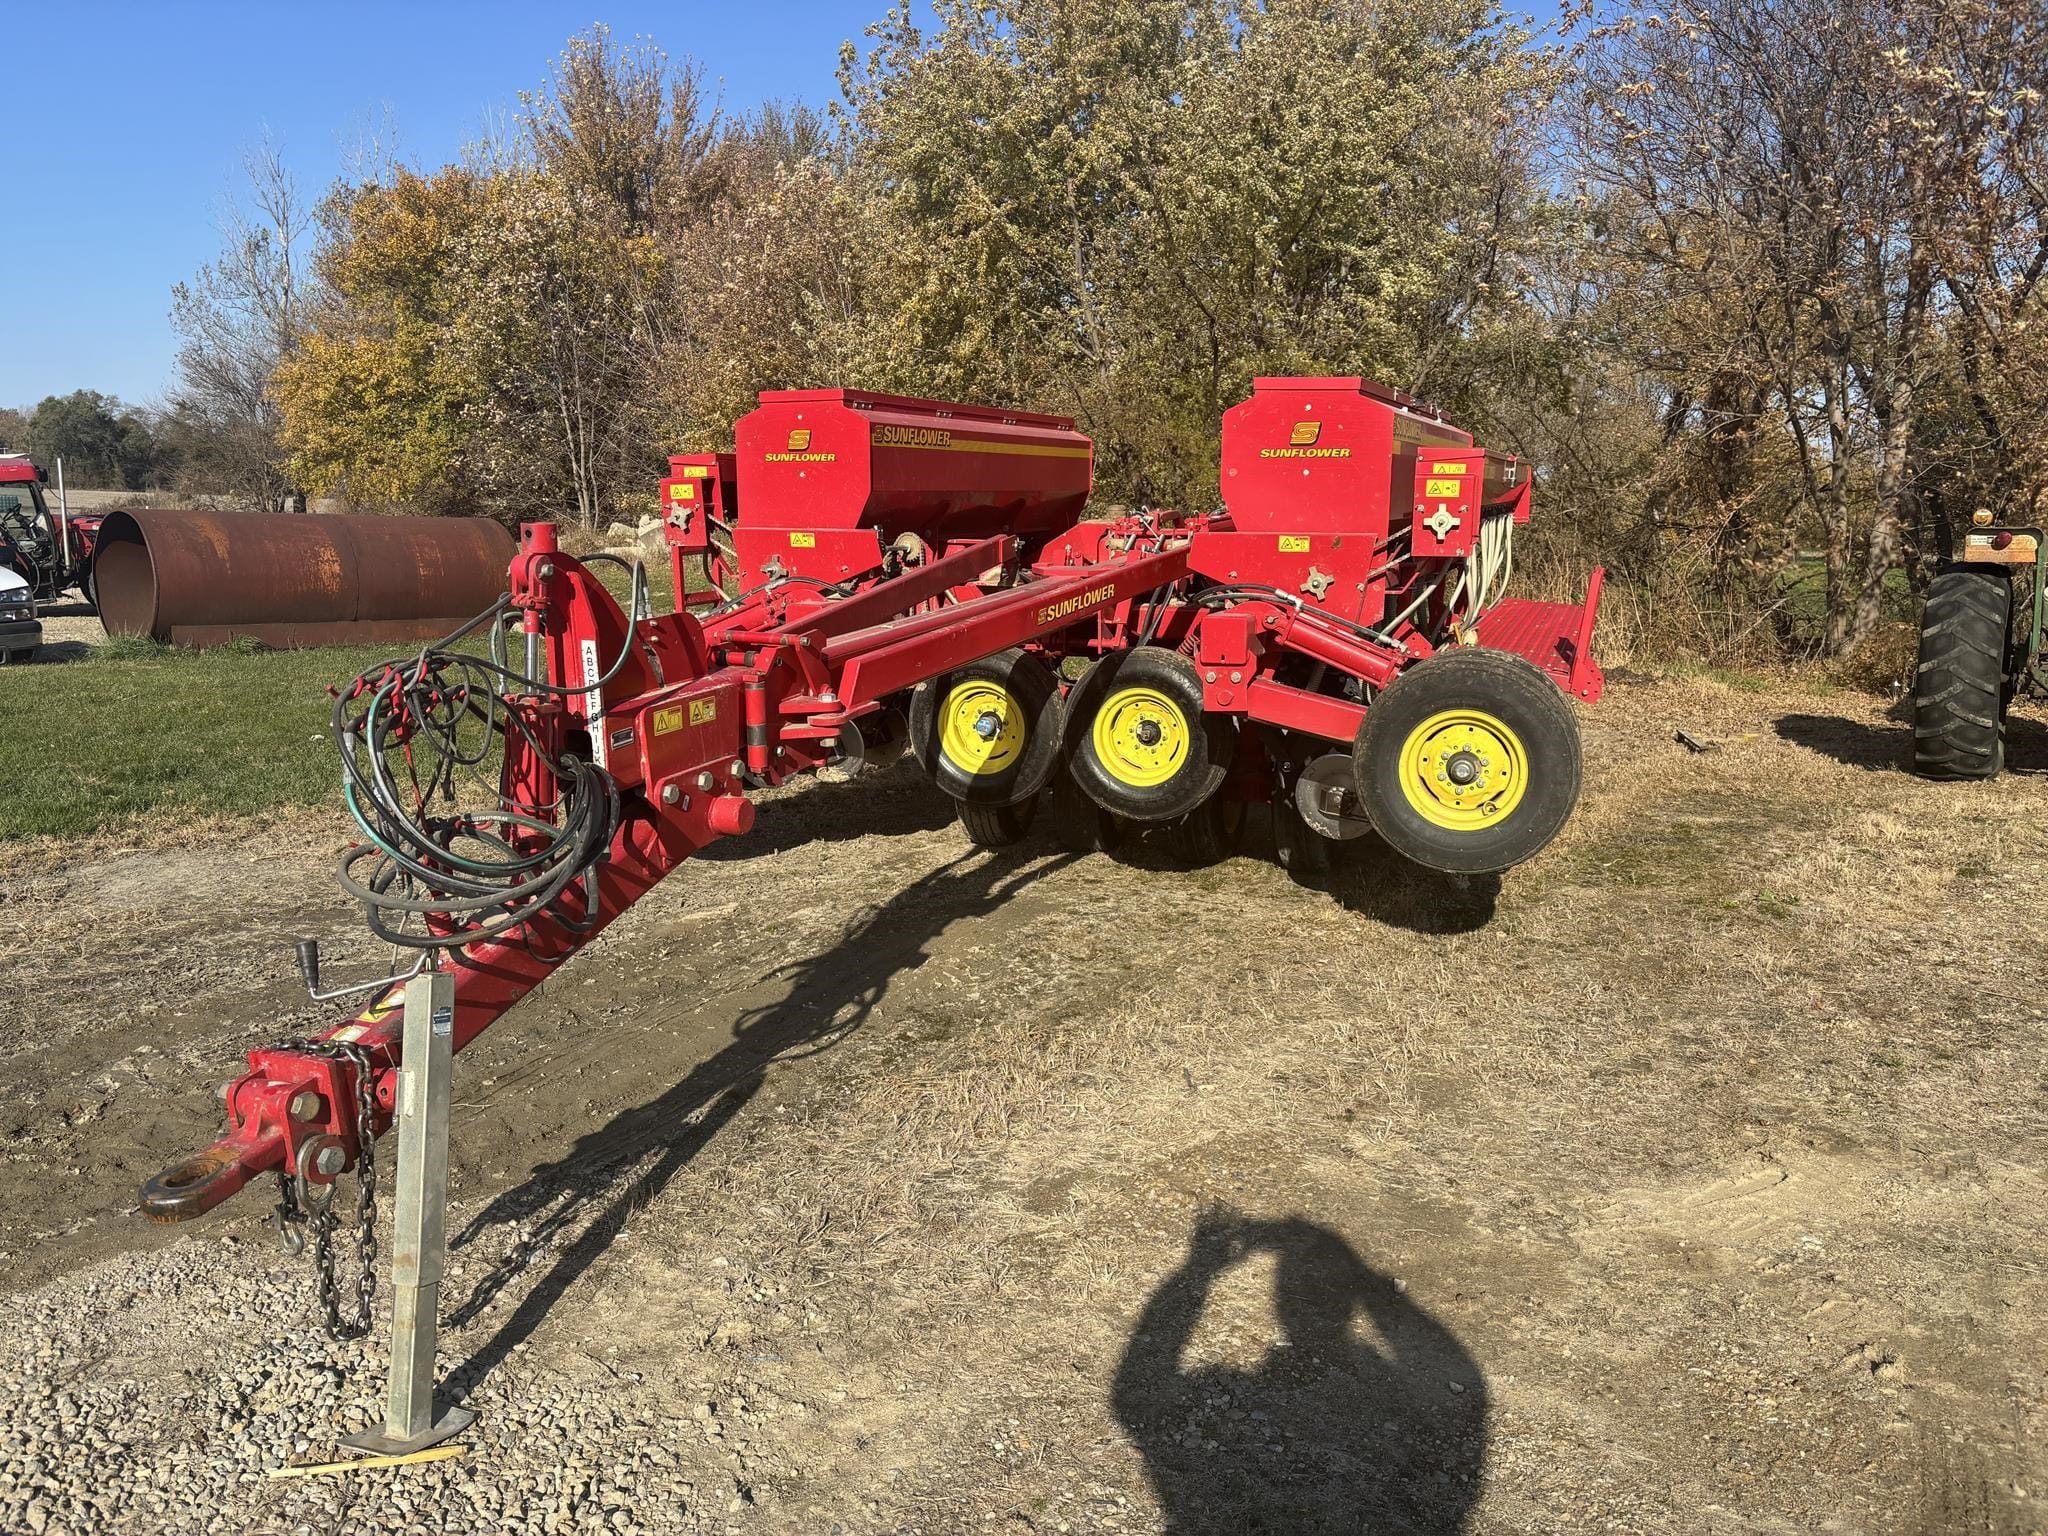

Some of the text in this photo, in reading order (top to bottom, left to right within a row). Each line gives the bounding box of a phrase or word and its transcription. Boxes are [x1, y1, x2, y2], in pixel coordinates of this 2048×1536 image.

[883, 426, 952, 447] SUNFLOWER
[765, 453, 836, 462] SUNFLOWER
[1260, 448, 1350, 458] SUNFLOWER
[1047, 584, 1115, 621] SUNFLOWER
